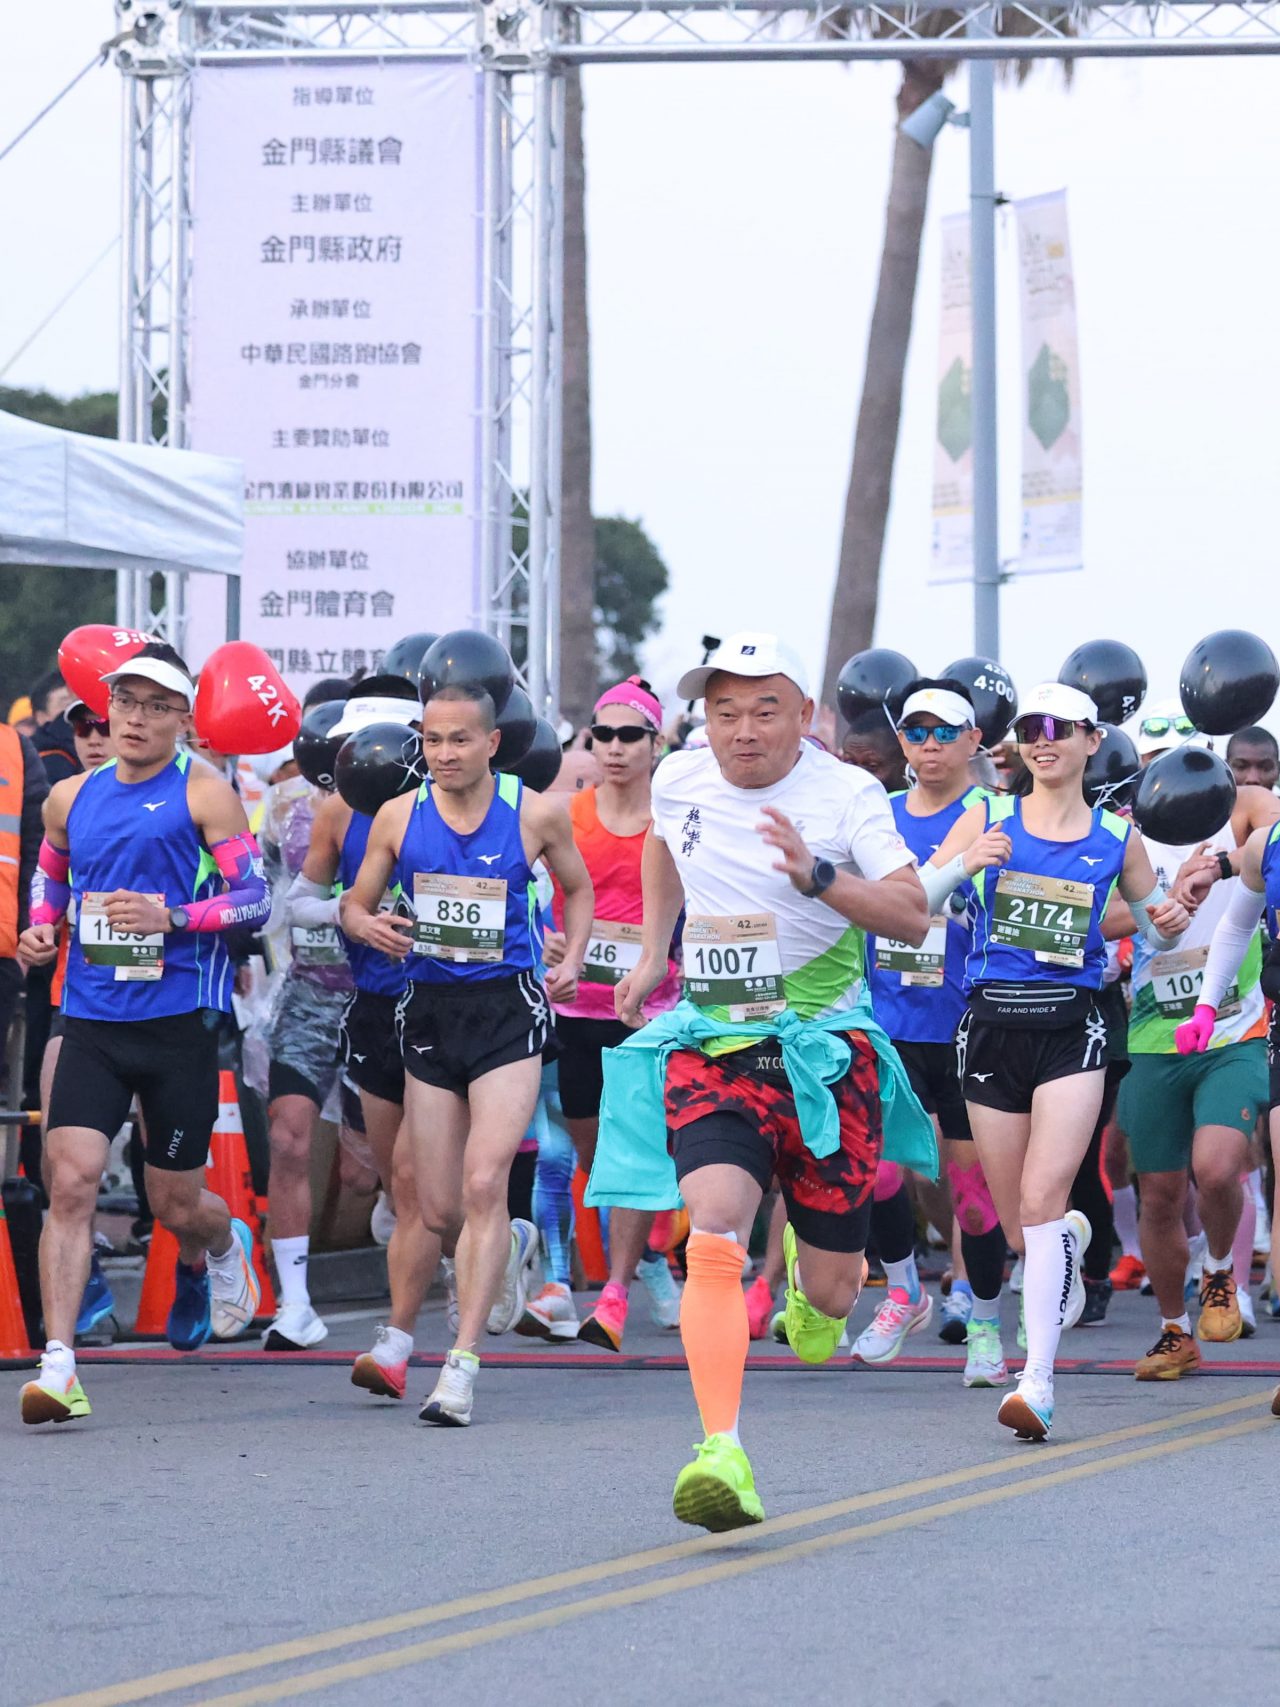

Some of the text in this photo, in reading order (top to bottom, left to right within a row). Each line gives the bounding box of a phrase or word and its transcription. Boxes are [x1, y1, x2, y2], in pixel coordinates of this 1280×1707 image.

[293, 86, 374, 106] 指導單位
[261, 136, 403, 166] 金門縣議會
[291, 193, 372, 213] 主辦單位
[260, 235, 402, 263] 金門縣政府
[290, 299, 371, 319] 承辦單位
[241, 342, 421, 365] 中華民國路跑協會
[298, 373, 359, 389] 金門分會
[272, 428, 390, 448] 主要贊助單位
[287, 550, 369, 571] 協辦單位
[260, 590, 395, 619] 金門體育會
[974, 675, 1014, 703] 4:00
[248, 674, 288, 727] 42K
[1063, 884, 1075, 893] 42
[437, 900, 481, 924] 836
[1007, 899, 1073, 930] 2174
[737, 920, 751, 929] 42
[589, 943, 617, 963] 46
[695, 947, 758, 975] 1007
[1029, 1006, 1049, 1014] WIDE
